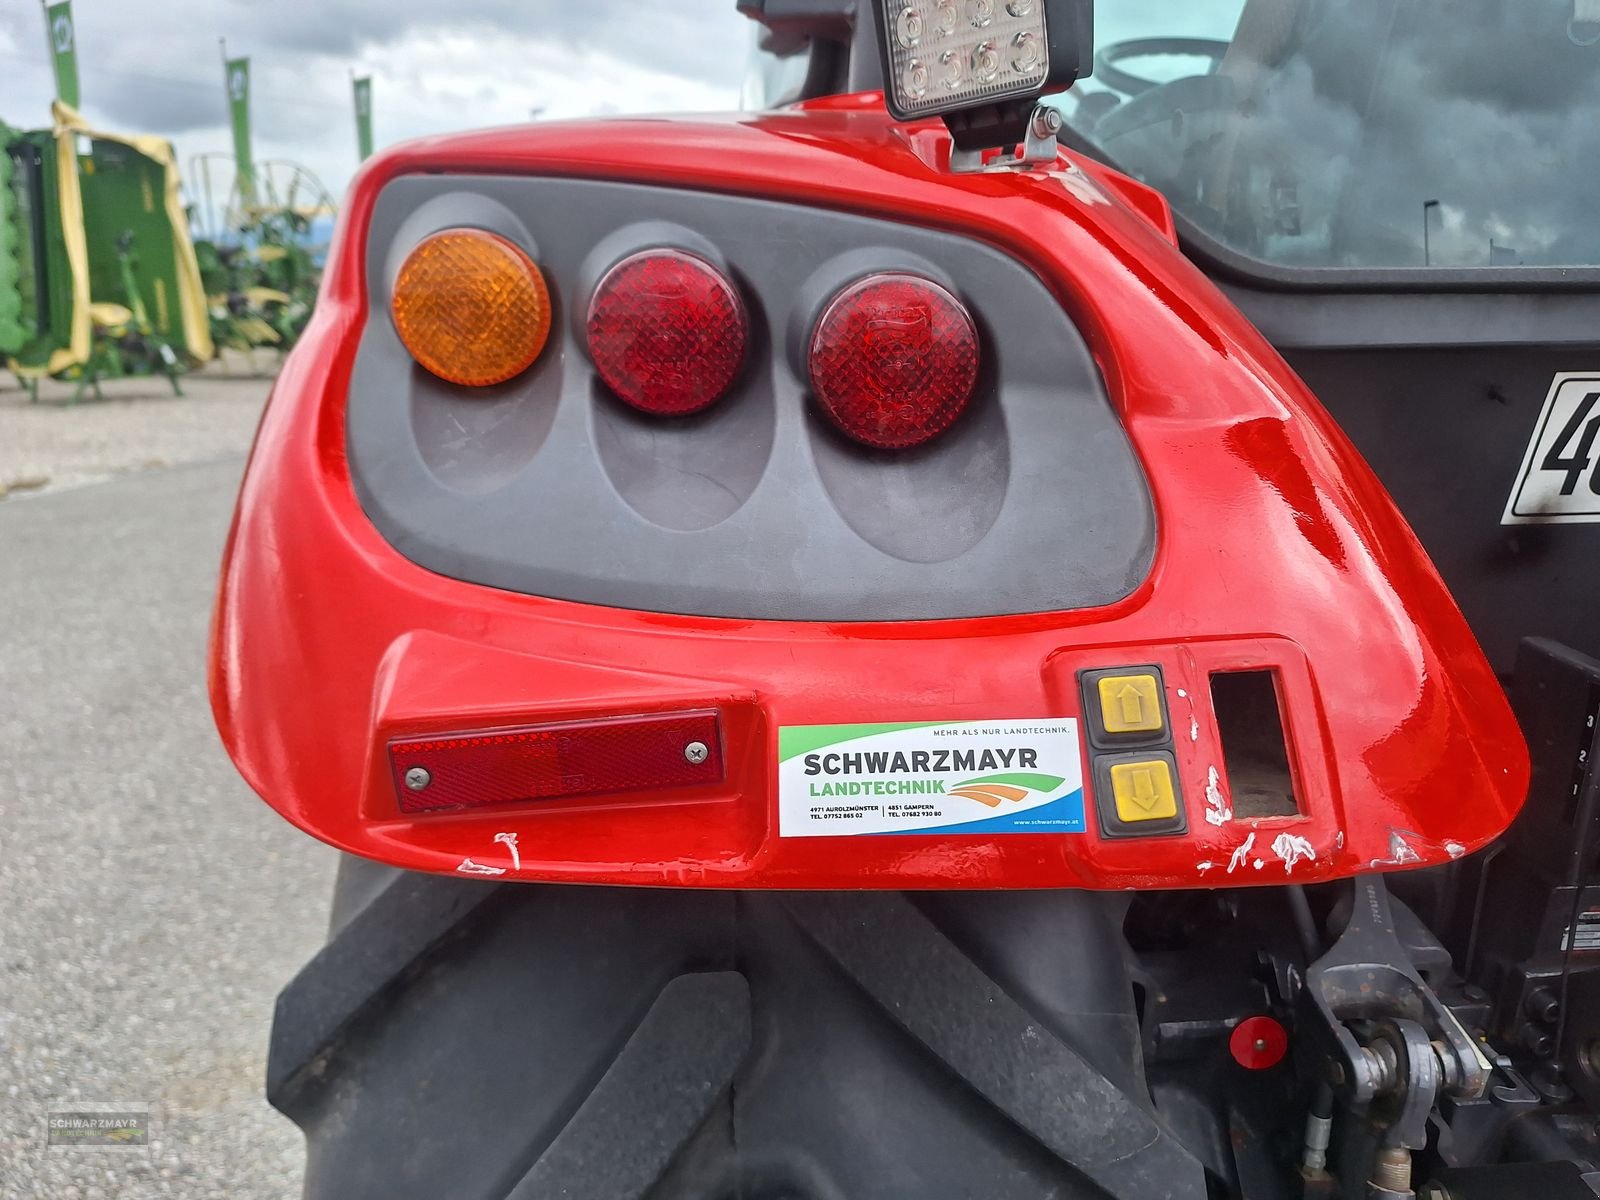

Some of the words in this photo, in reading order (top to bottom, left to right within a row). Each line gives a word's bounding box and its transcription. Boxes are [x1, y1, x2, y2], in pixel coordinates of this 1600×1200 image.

[1540, 392, 1600, 496] 4
[1586, 714, 1594, 728] 3
[933, 729, 958, 737] MEHR
[961, 728, 979, 736] ALS
[1003, 726, 1070, 735] LANDTECHNIK.
[803, 748, 1038, 776] SCHWARZMAYR
[1579, 749, 1587, 762] 2
[809, 779, 946, 797] LANDTECHNIK
[1572, 783, 1578, 796] 1
